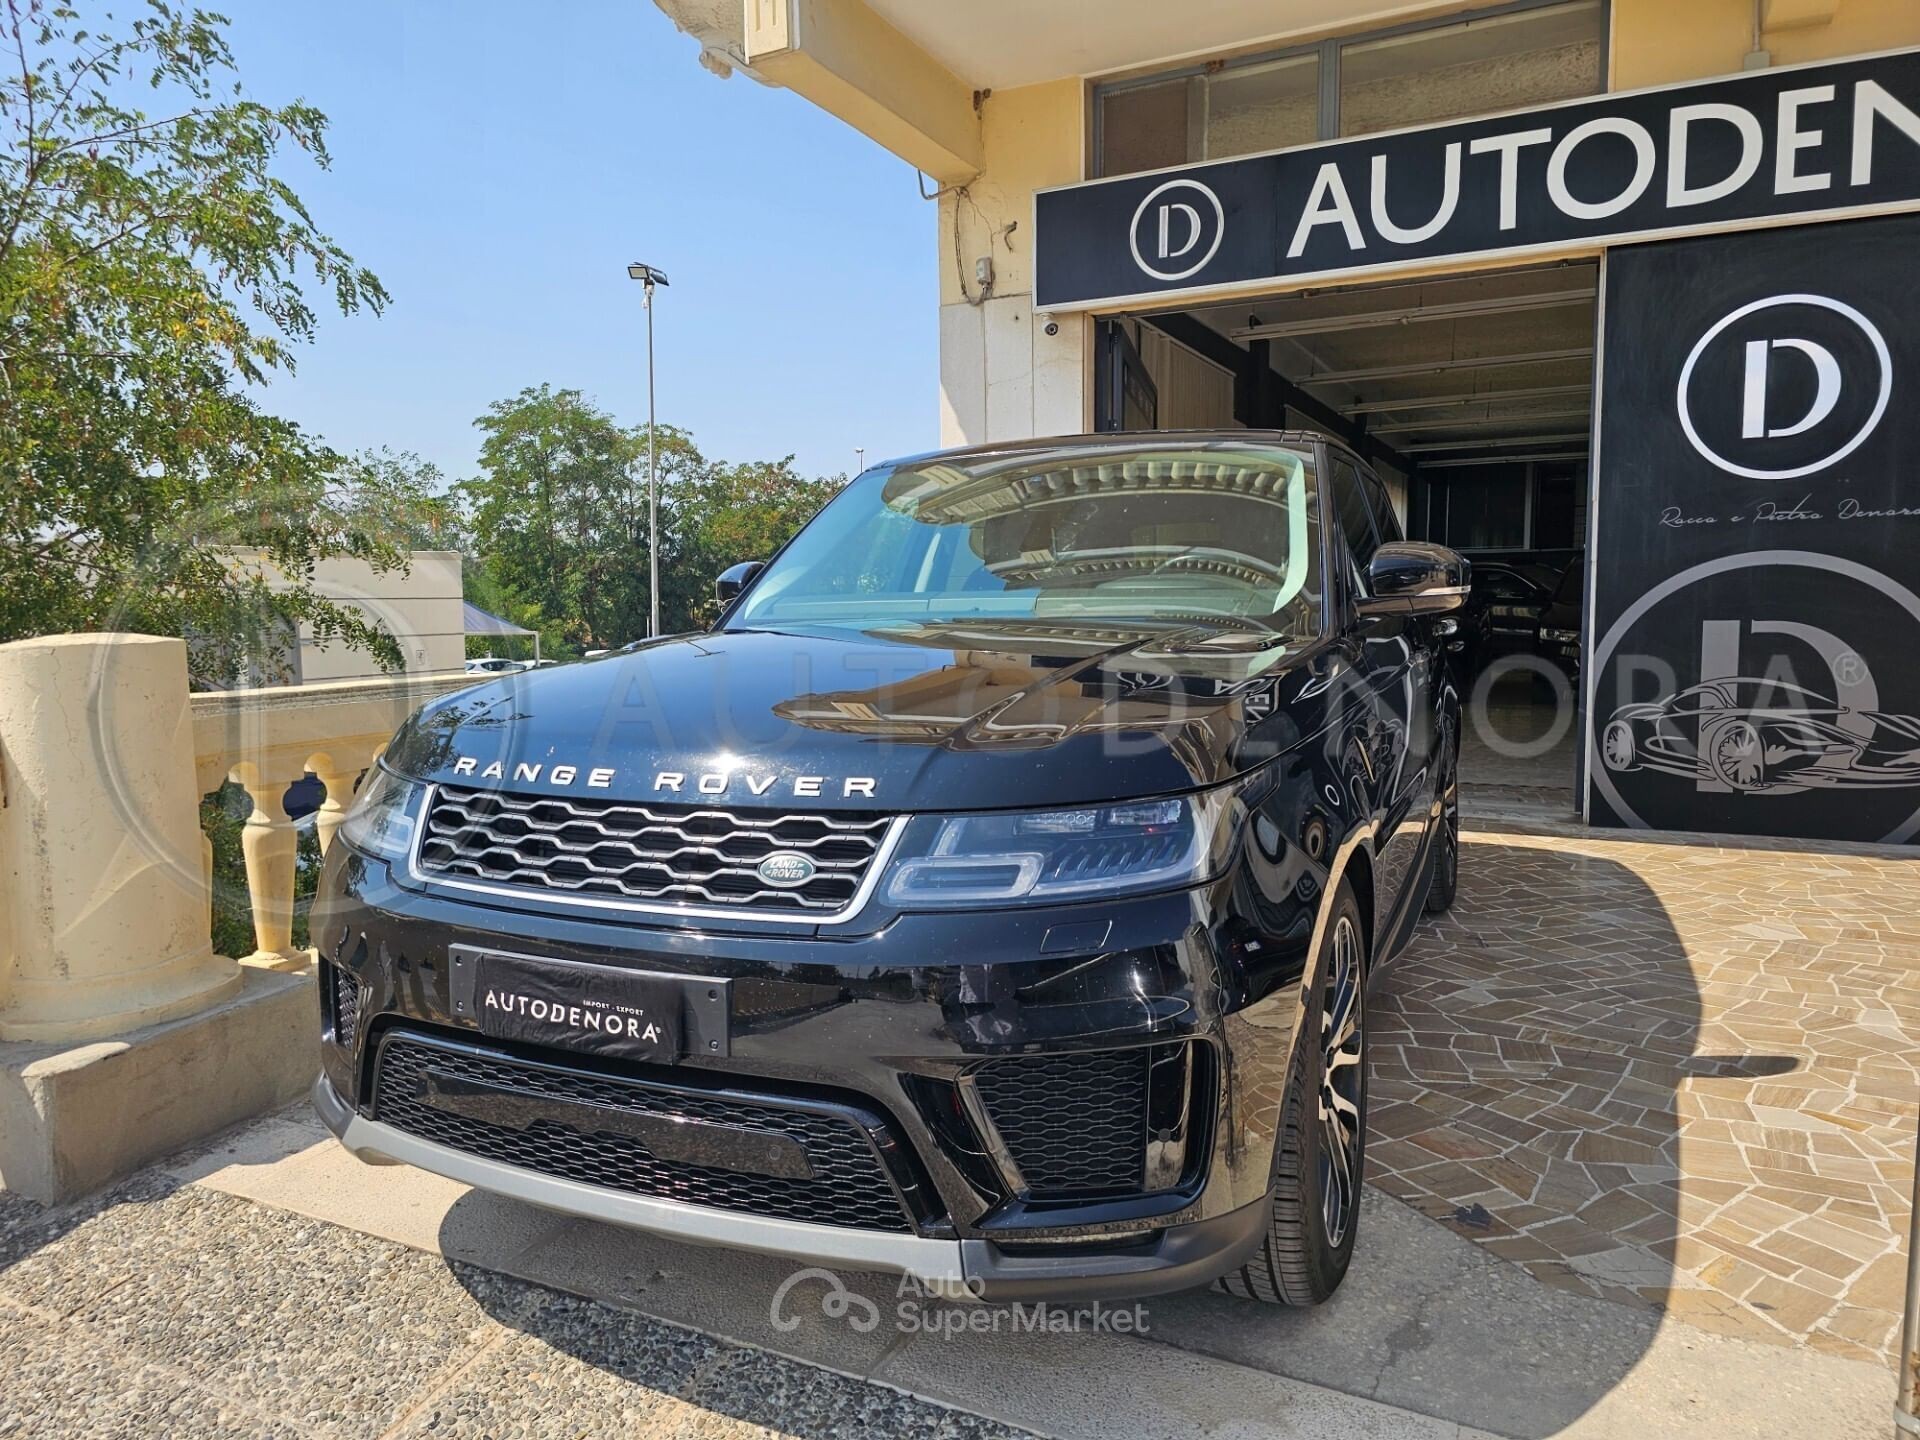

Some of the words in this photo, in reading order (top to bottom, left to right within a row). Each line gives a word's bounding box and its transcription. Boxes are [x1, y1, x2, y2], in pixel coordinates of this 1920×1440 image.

[1287, 79, 1920, 259] AUTODEN
[1658, 506, 1718, 528] Rocco
[1753, 493, 1824, 525] Pietro
[453, 757, 616, 788] RANGE
[654, 772, 878, 798] ROVER
[769, 858, 798, 869] LAND
[770, 868, 805, 879] ROVER
[583, 999, 610, 1010] IMPORT
[616, 1005, 644, 1017] EXPORT
